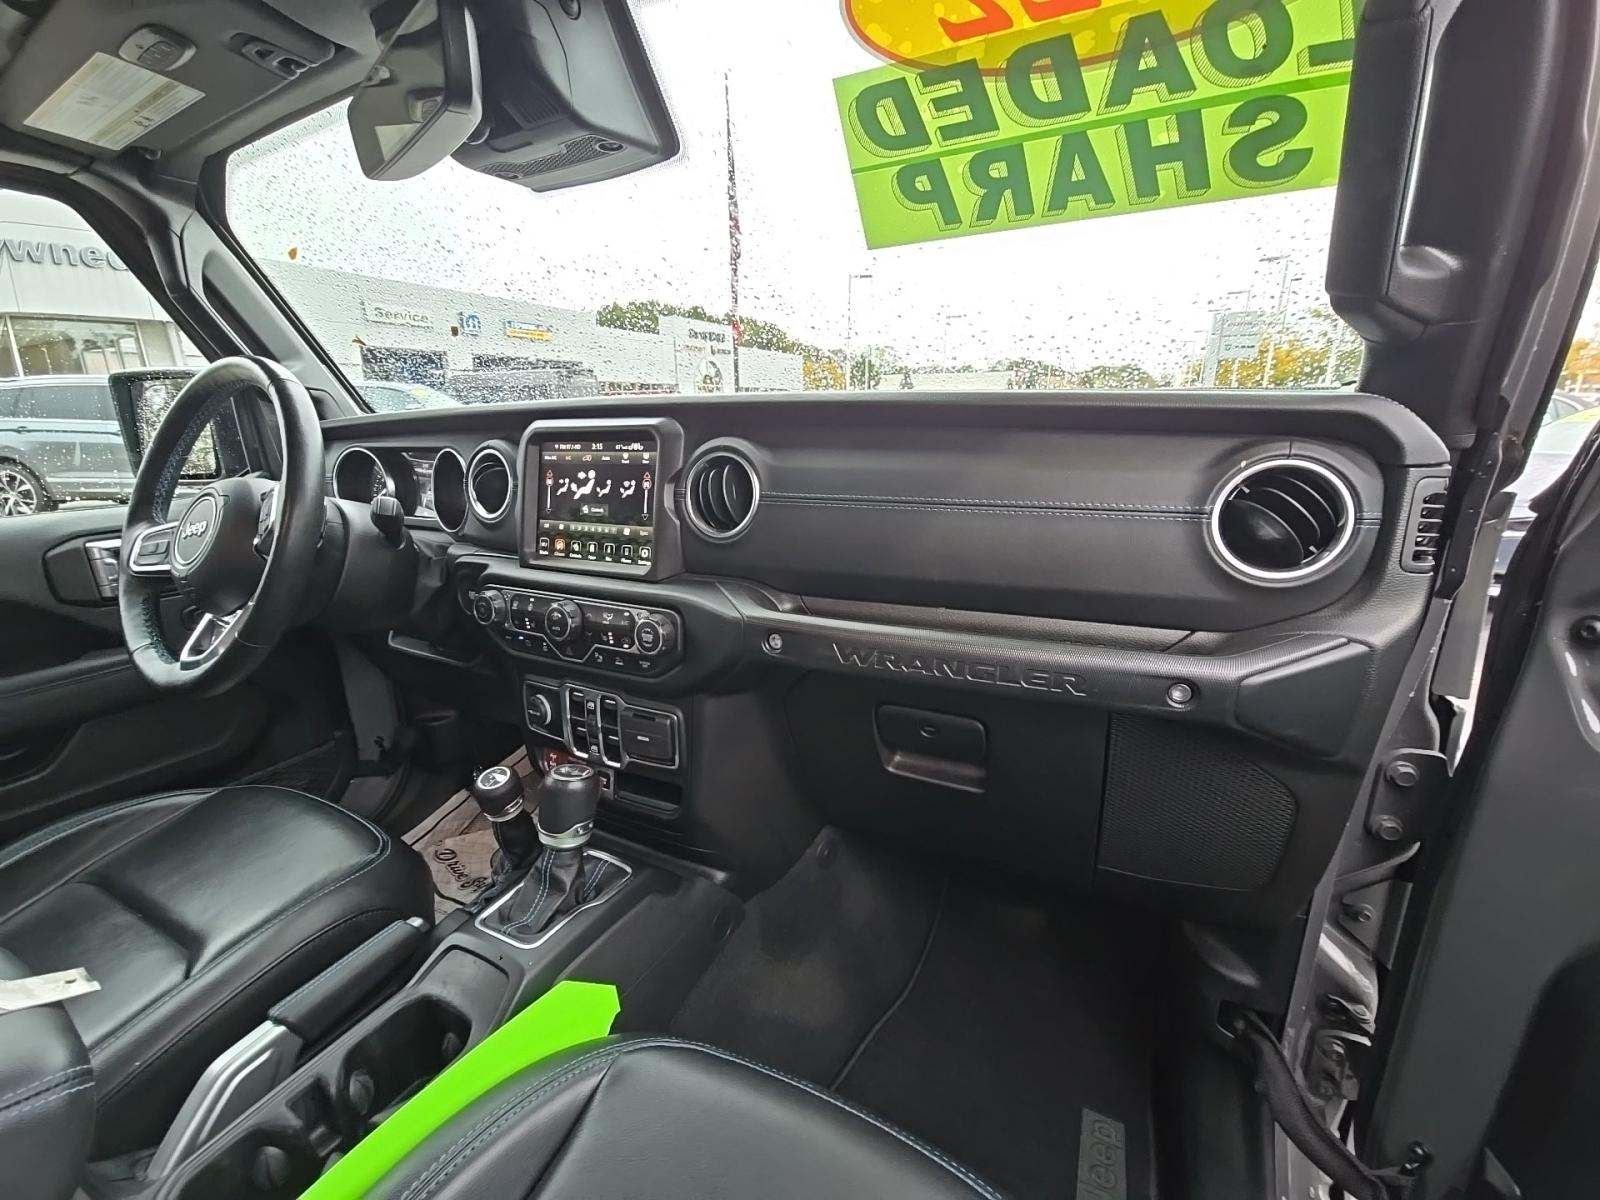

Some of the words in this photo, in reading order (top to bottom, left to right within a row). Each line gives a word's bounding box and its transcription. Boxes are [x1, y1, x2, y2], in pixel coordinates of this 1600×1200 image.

[374, 307, 429, 322] Service
[181, 519, 208, 540] Jeep
[832, 642, 1087, 697] WRANGLER
[434, 848, 468, 882] Drive
